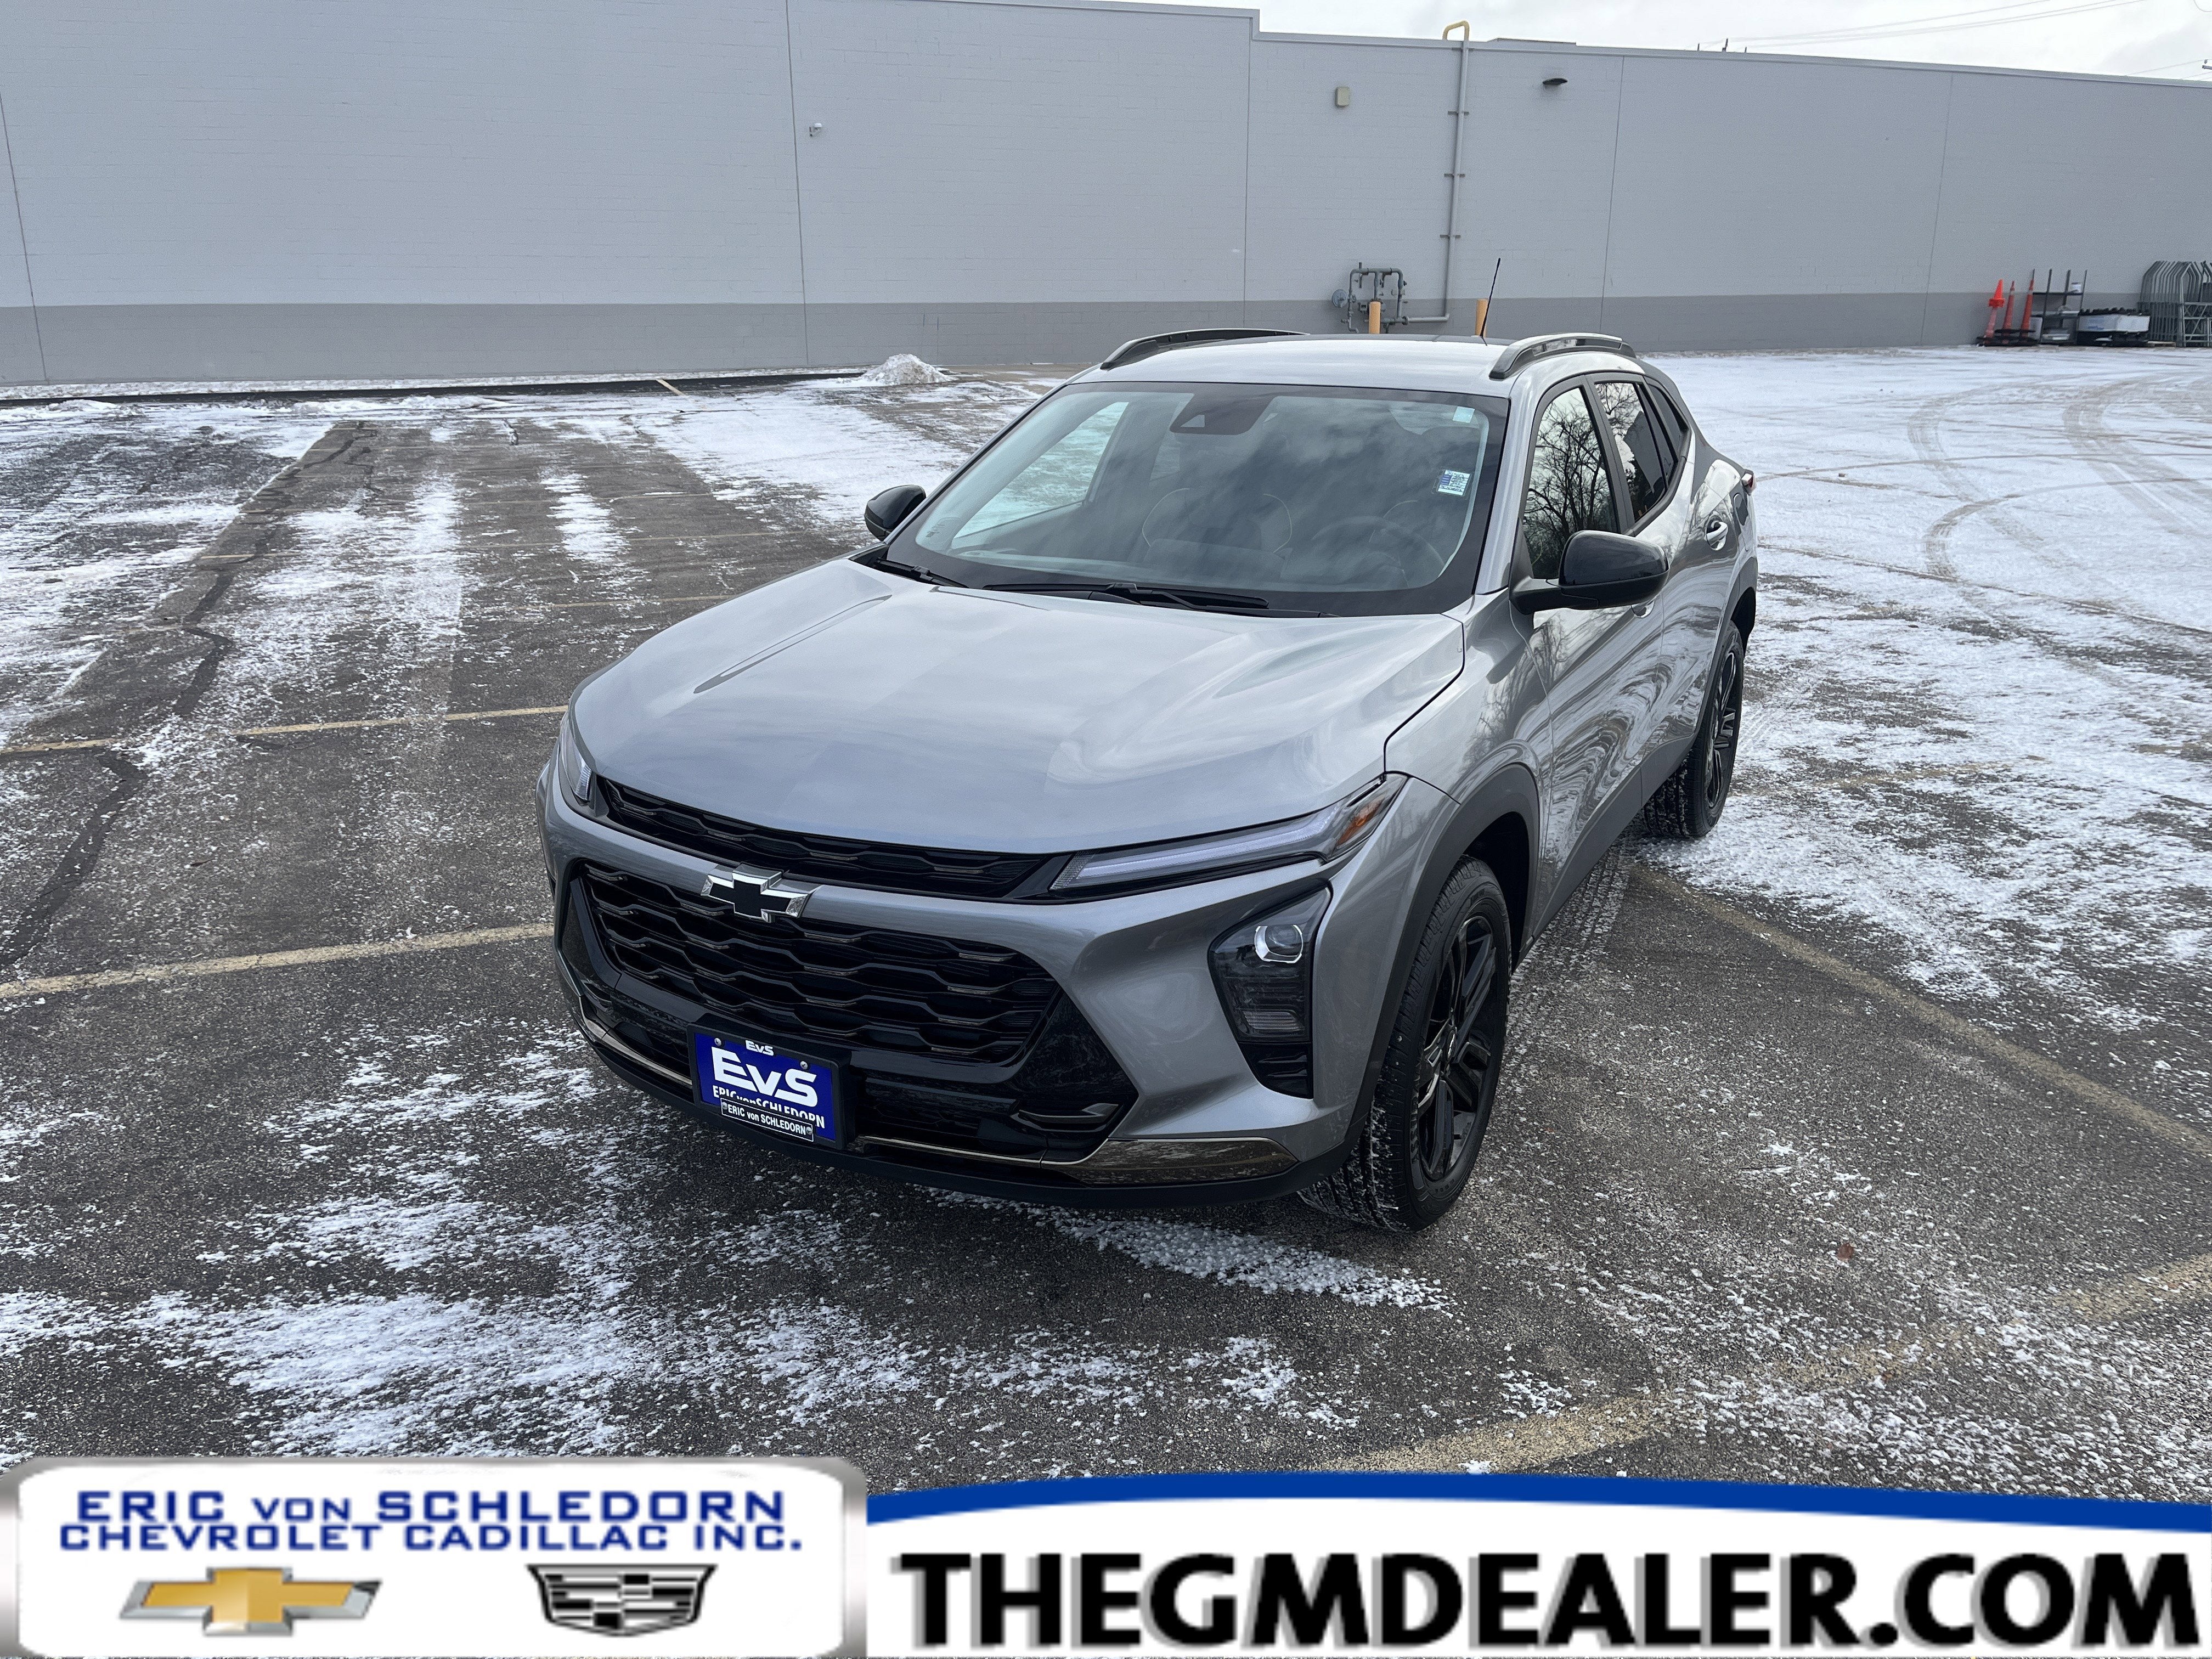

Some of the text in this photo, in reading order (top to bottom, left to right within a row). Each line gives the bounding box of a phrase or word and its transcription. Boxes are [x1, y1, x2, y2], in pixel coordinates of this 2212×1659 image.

[727, 1104, 806, 1136] ERIC von SCHLEDORN
